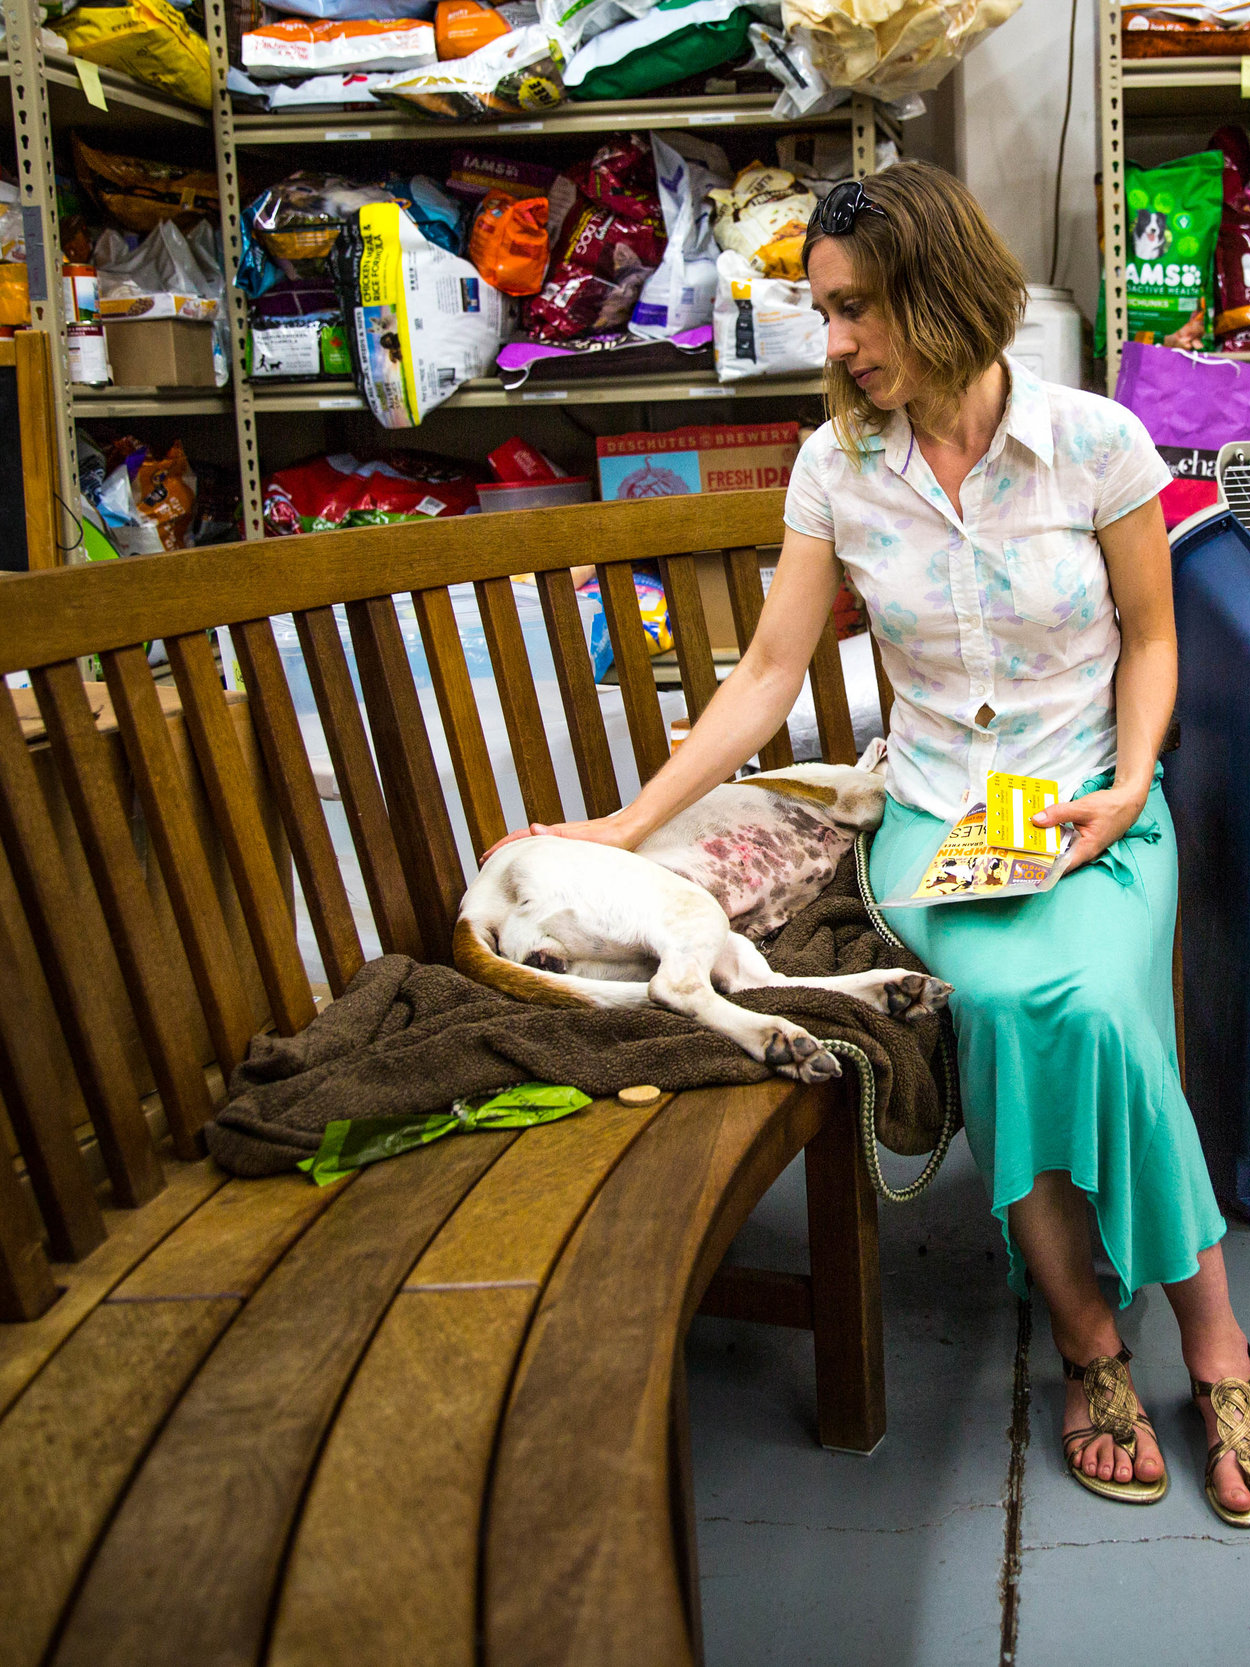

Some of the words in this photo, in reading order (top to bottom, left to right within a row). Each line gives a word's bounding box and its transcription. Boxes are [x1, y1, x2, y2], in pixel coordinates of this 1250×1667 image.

[1125, 263, 1181, 287] AMS
[373, 277, 381, 301] RICE
[607, 436, 696, 453] DESCHUTES
[716, 430, 791, 445] BREWERY
[707, 469, 753, 488] FRESH
[756, 465, 791, 488] IPA
[936, 846, 1009, 858] PUMPKIN
[1013, 869, 1045, 880] DOG
